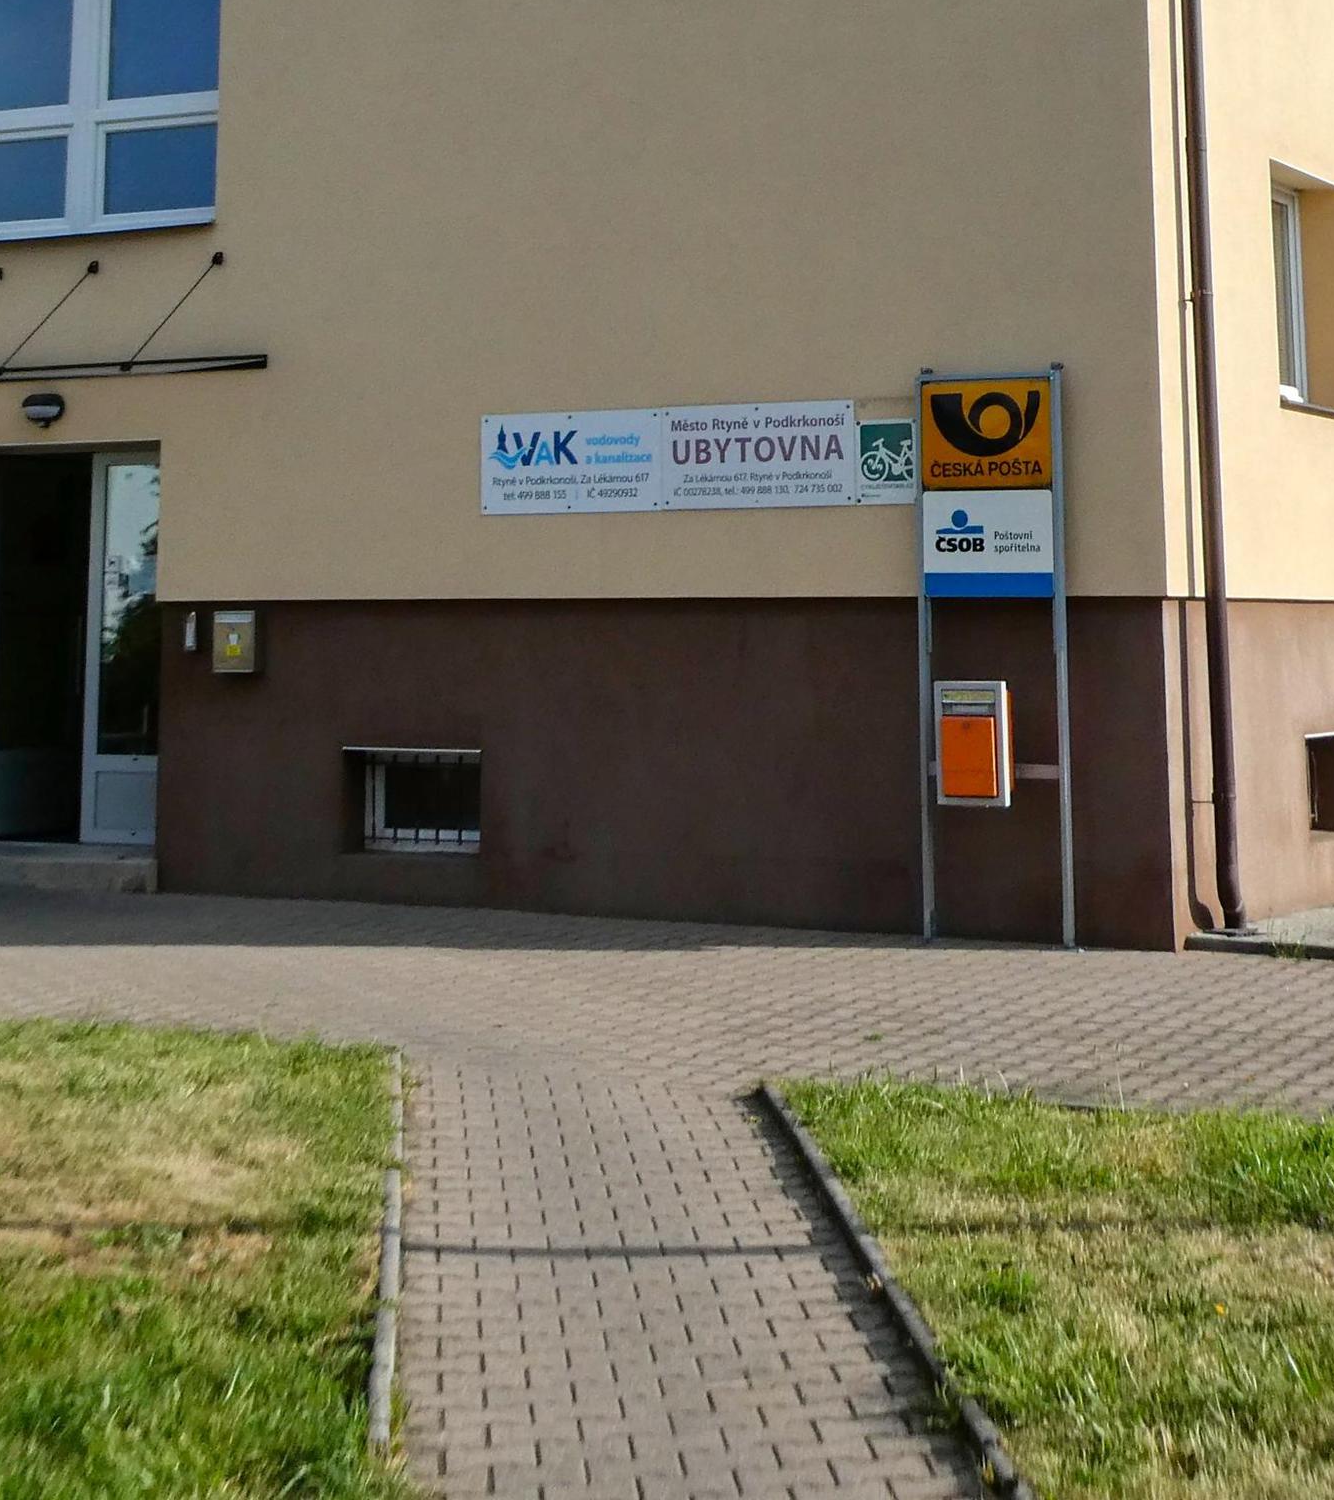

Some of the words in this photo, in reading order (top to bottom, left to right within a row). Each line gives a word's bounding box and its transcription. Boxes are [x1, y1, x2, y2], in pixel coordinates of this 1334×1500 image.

[671, 419, 708, 432] Město
[712, 417, 749, 433] Rtyně
[753, 419, 761, 429] v
[765, 414, 845, 428] Podkrkonoší
[585, 433, 641, 447] vodovody
[672, 434, 844, 466] UBYTOVNA
[585, 455, 593, 464] a
[594, 452, 653, 464] kanalizace
[930, 460, 984, 478] ČESKÁ
[988, 458, 1043, 476] POŠTA
[580, 474, 591, 484] Za
[635, 472, 650, 483] 617
[683, 474, 694, 483] Za
[534, 490, 551, 500] 888
[554, 489, 567, 499] 155
[757, 485, 772, 494] 888
[794, 484, 809, 493] 724
[811, 483, 825, 493] 735
[827, 483, 843, 493] 002
[994, 531, 1033, 540] Poštovní
[935, 536, 985, 553] ČSOB
[994, 543, 1041, 554] spořitelna
